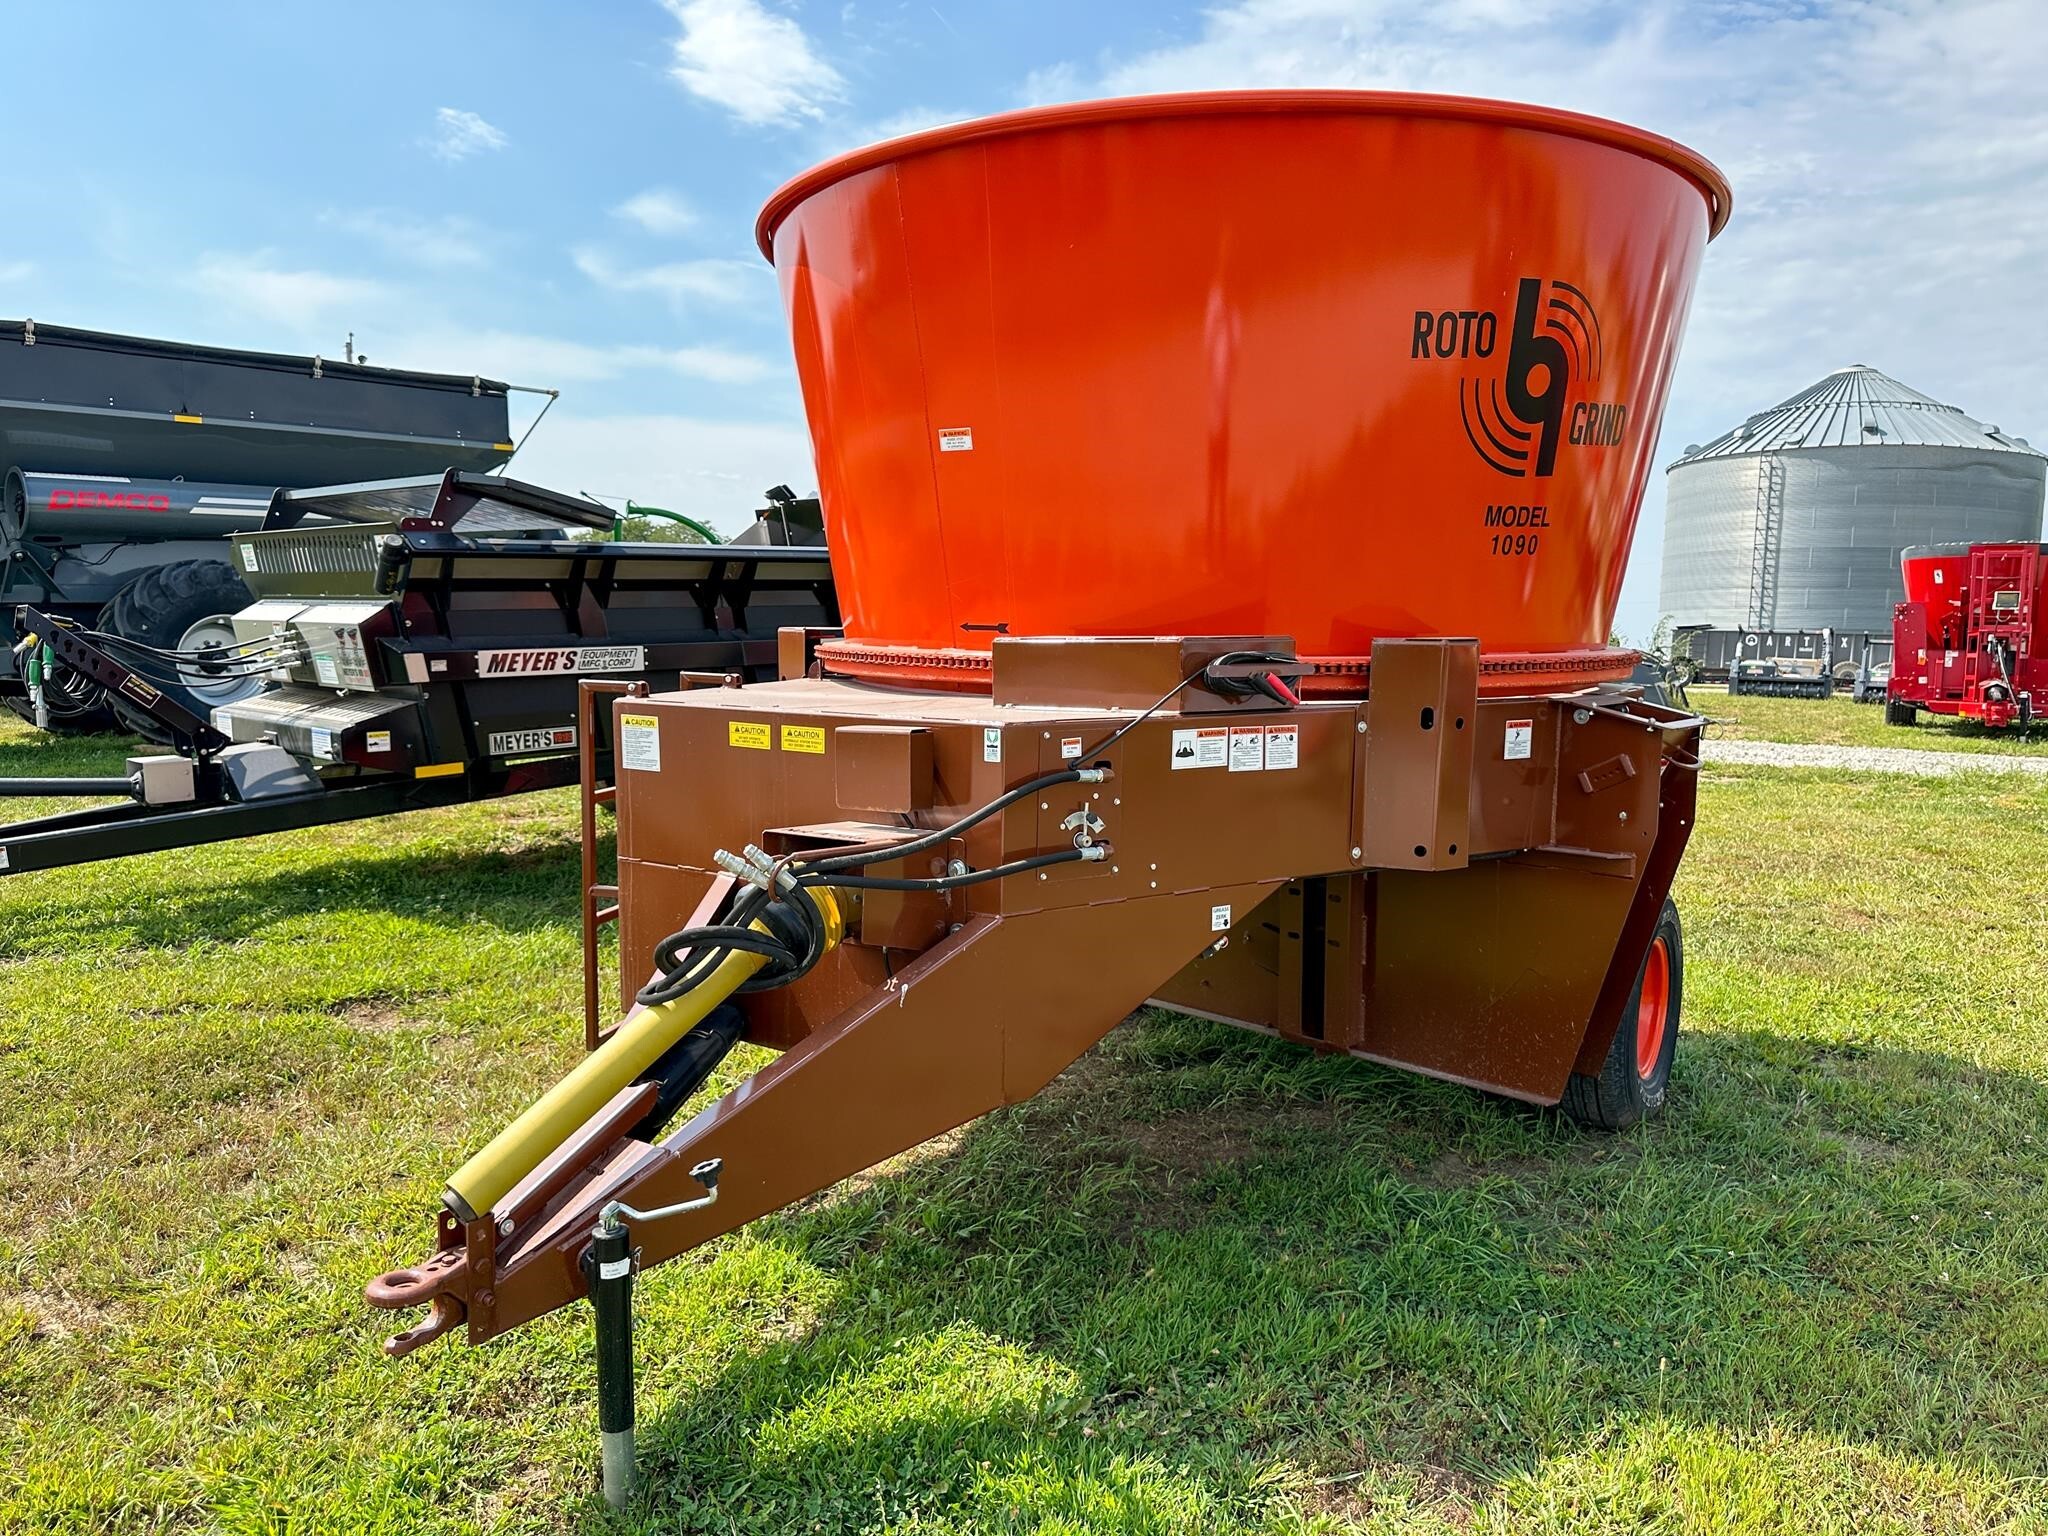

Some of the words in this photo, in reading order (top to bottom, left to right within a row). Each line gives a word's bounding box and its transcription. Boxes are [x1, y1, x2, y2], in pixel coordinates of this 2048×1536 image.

[1411, 311, 1498, 359] ROTO
[1568, 402, 1628, 447] GRIND
[48, 489, 170, 513] DEMCO
[1484, 505, 1550, 528] MODEL
[1491, 534, 1538, 556] 1090
[487, 651, 577, 673] MEYER'S
[582, 650, 635, 660] EQUIPMENT
[630, 718, 655, 727] CAUTION
[740, 726, 766, 735] CAUTION
[493, 732, 552, 752] MEYER'S
[793, 730, 820, 739] CAUTION
